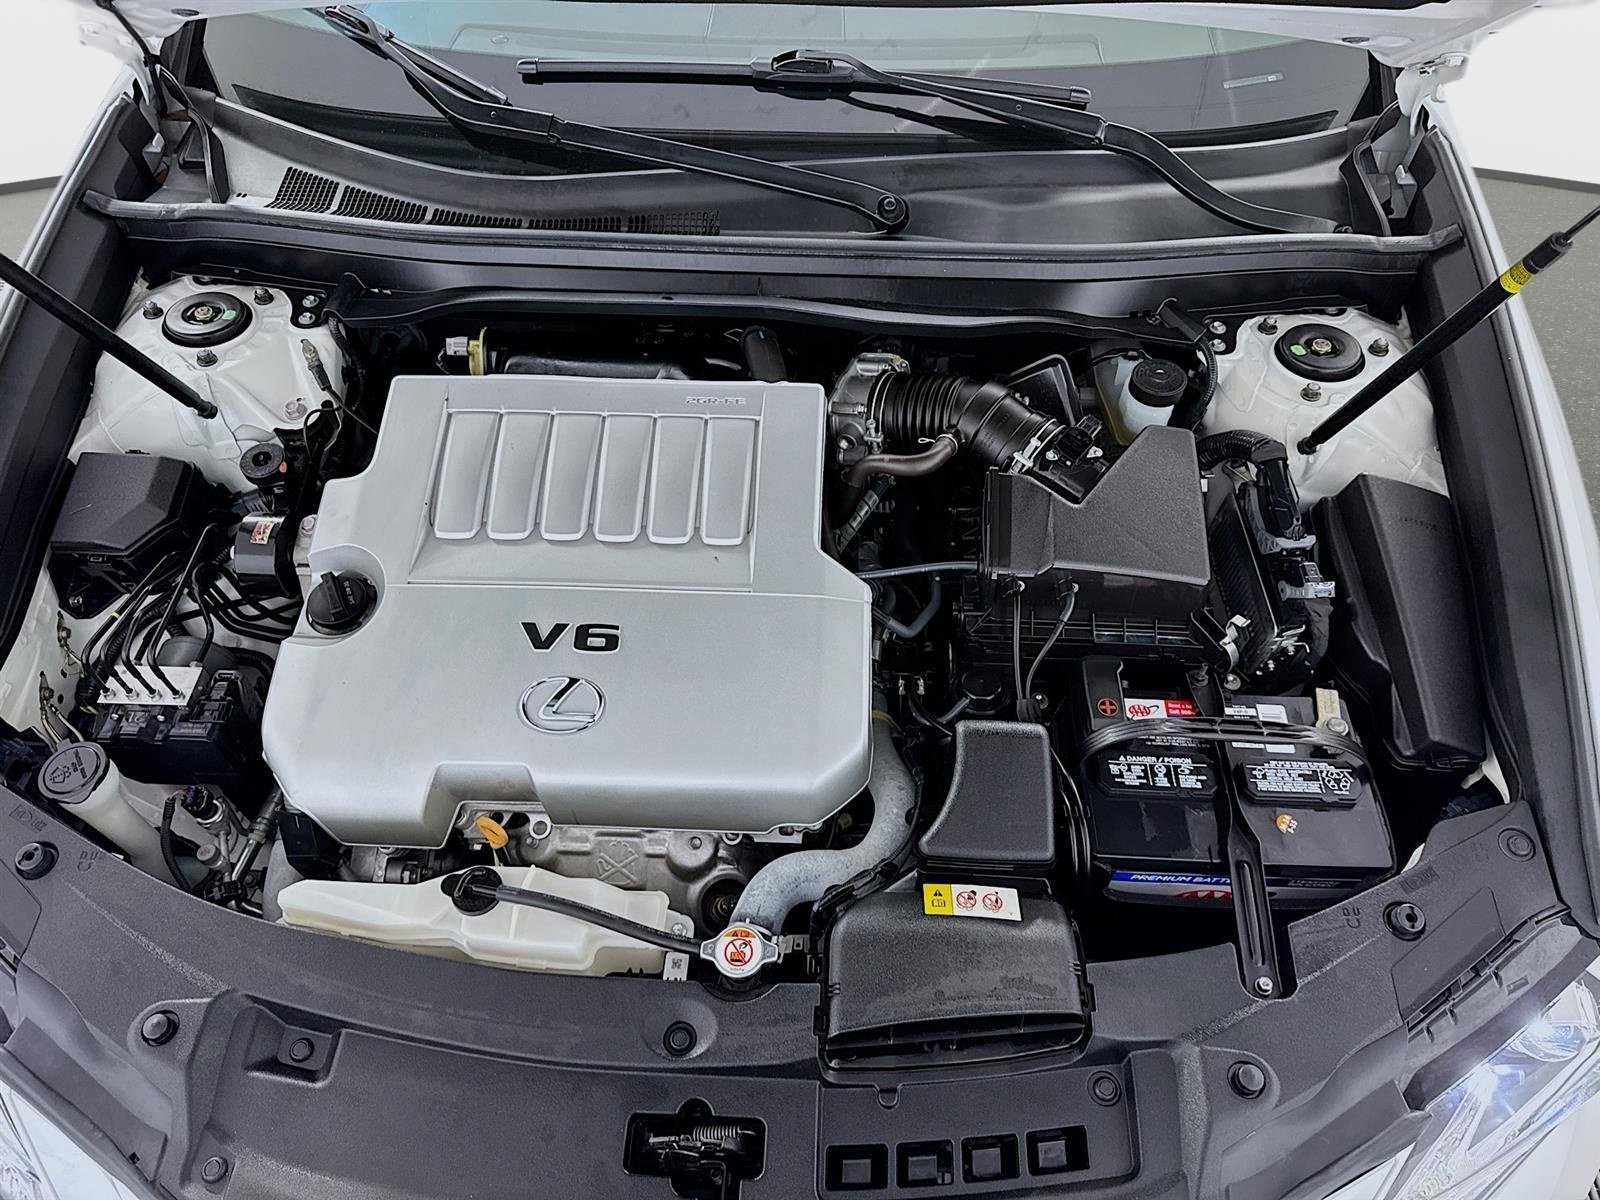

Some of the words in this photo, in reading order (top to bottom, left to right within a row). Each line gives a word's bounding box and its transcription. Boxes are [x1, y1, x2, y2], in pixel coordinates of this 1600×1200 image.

[519, 620, 622, 655] V6
[1128, 704, 1151, 717] AAA
[1126, 755, 1157, 763] DANGER
[1130, 874, 1192, 883] PREMIUM
